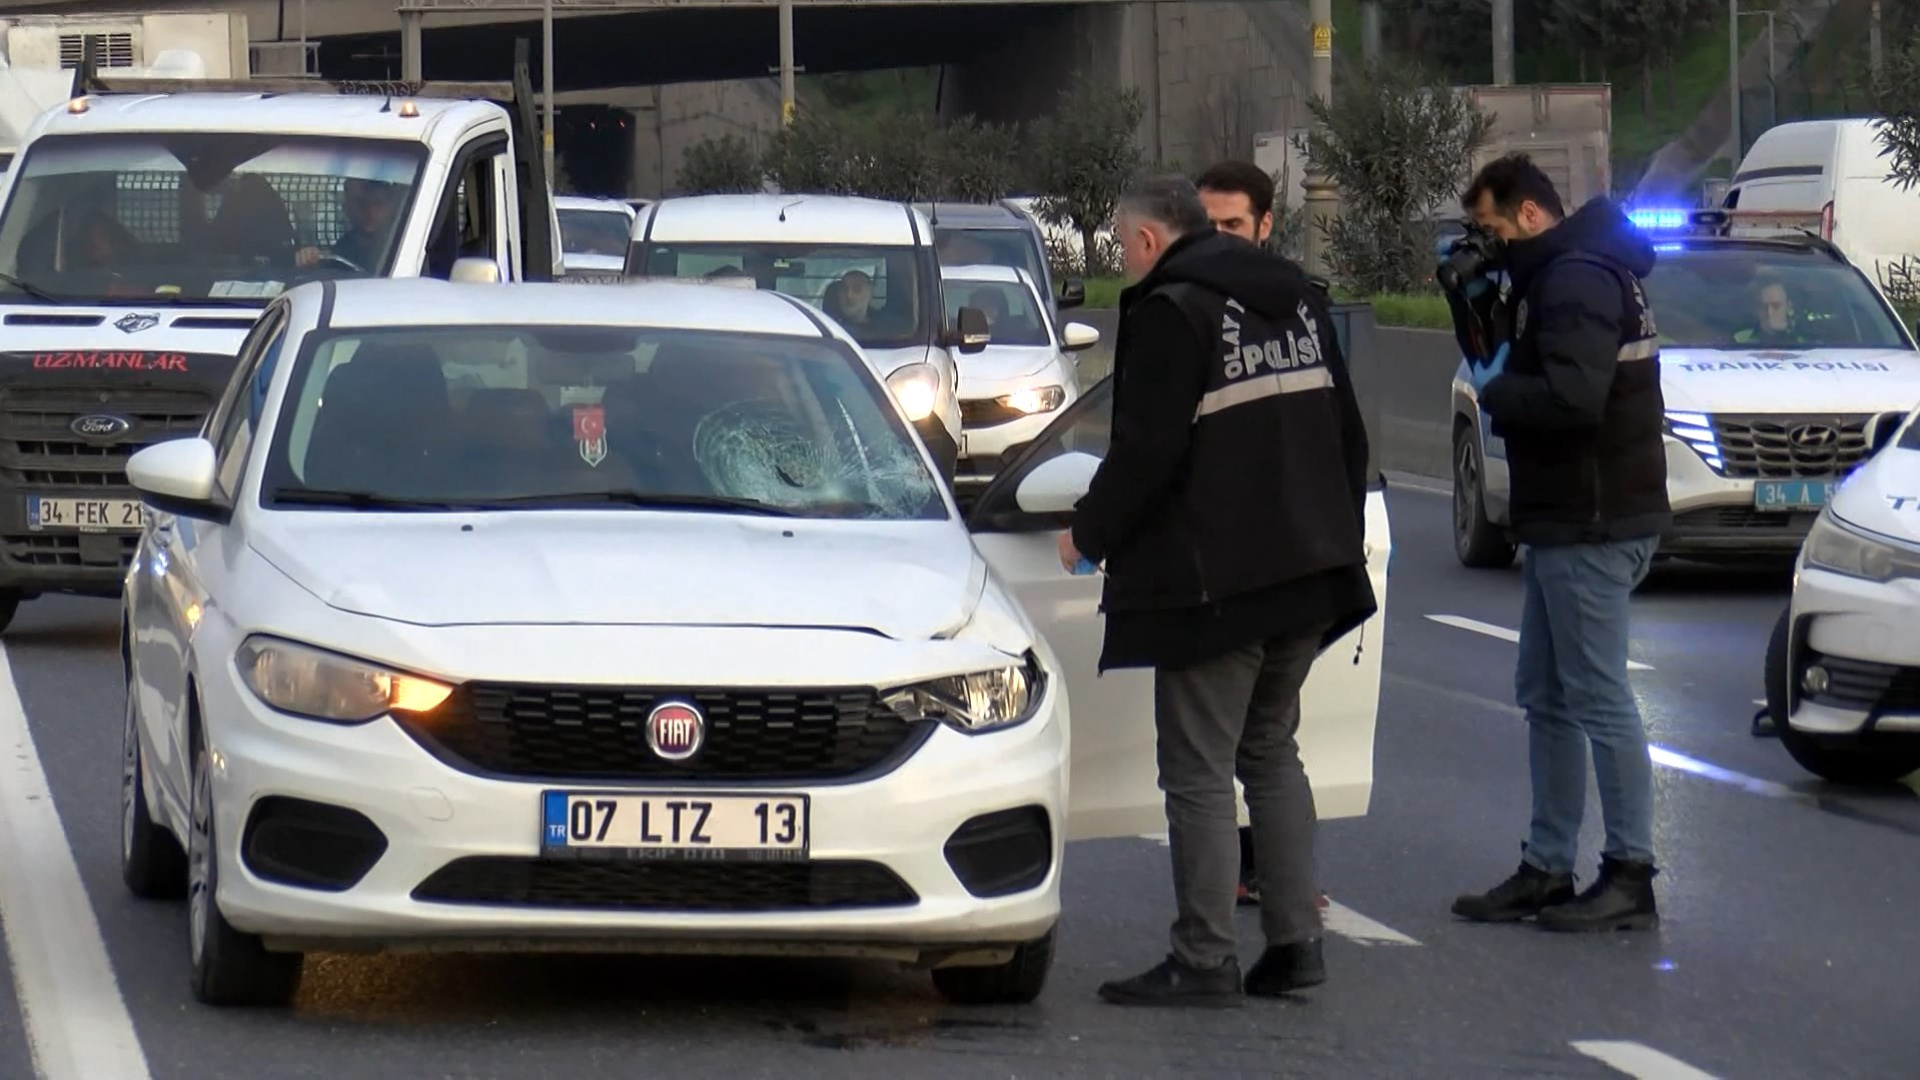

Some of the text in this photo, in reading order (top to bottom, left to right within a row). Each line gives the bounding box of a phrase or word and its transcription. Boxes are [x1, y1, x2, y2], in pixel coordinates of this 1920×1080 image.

[33, 352, 188, 371] UZMANLAR
[82, 418, 114, 432] Ford
[1766, 485, 1786, 504] 34
[1800, 483, 1810, 504] A
[42, 501, 62, 523] 34
[75, 502, 109, 524] FEK
[659, 718, 693, 746] FIAT
[549, 824, 566, 838] TR
[570, 800, 797, 844] 07 LTZ 13
